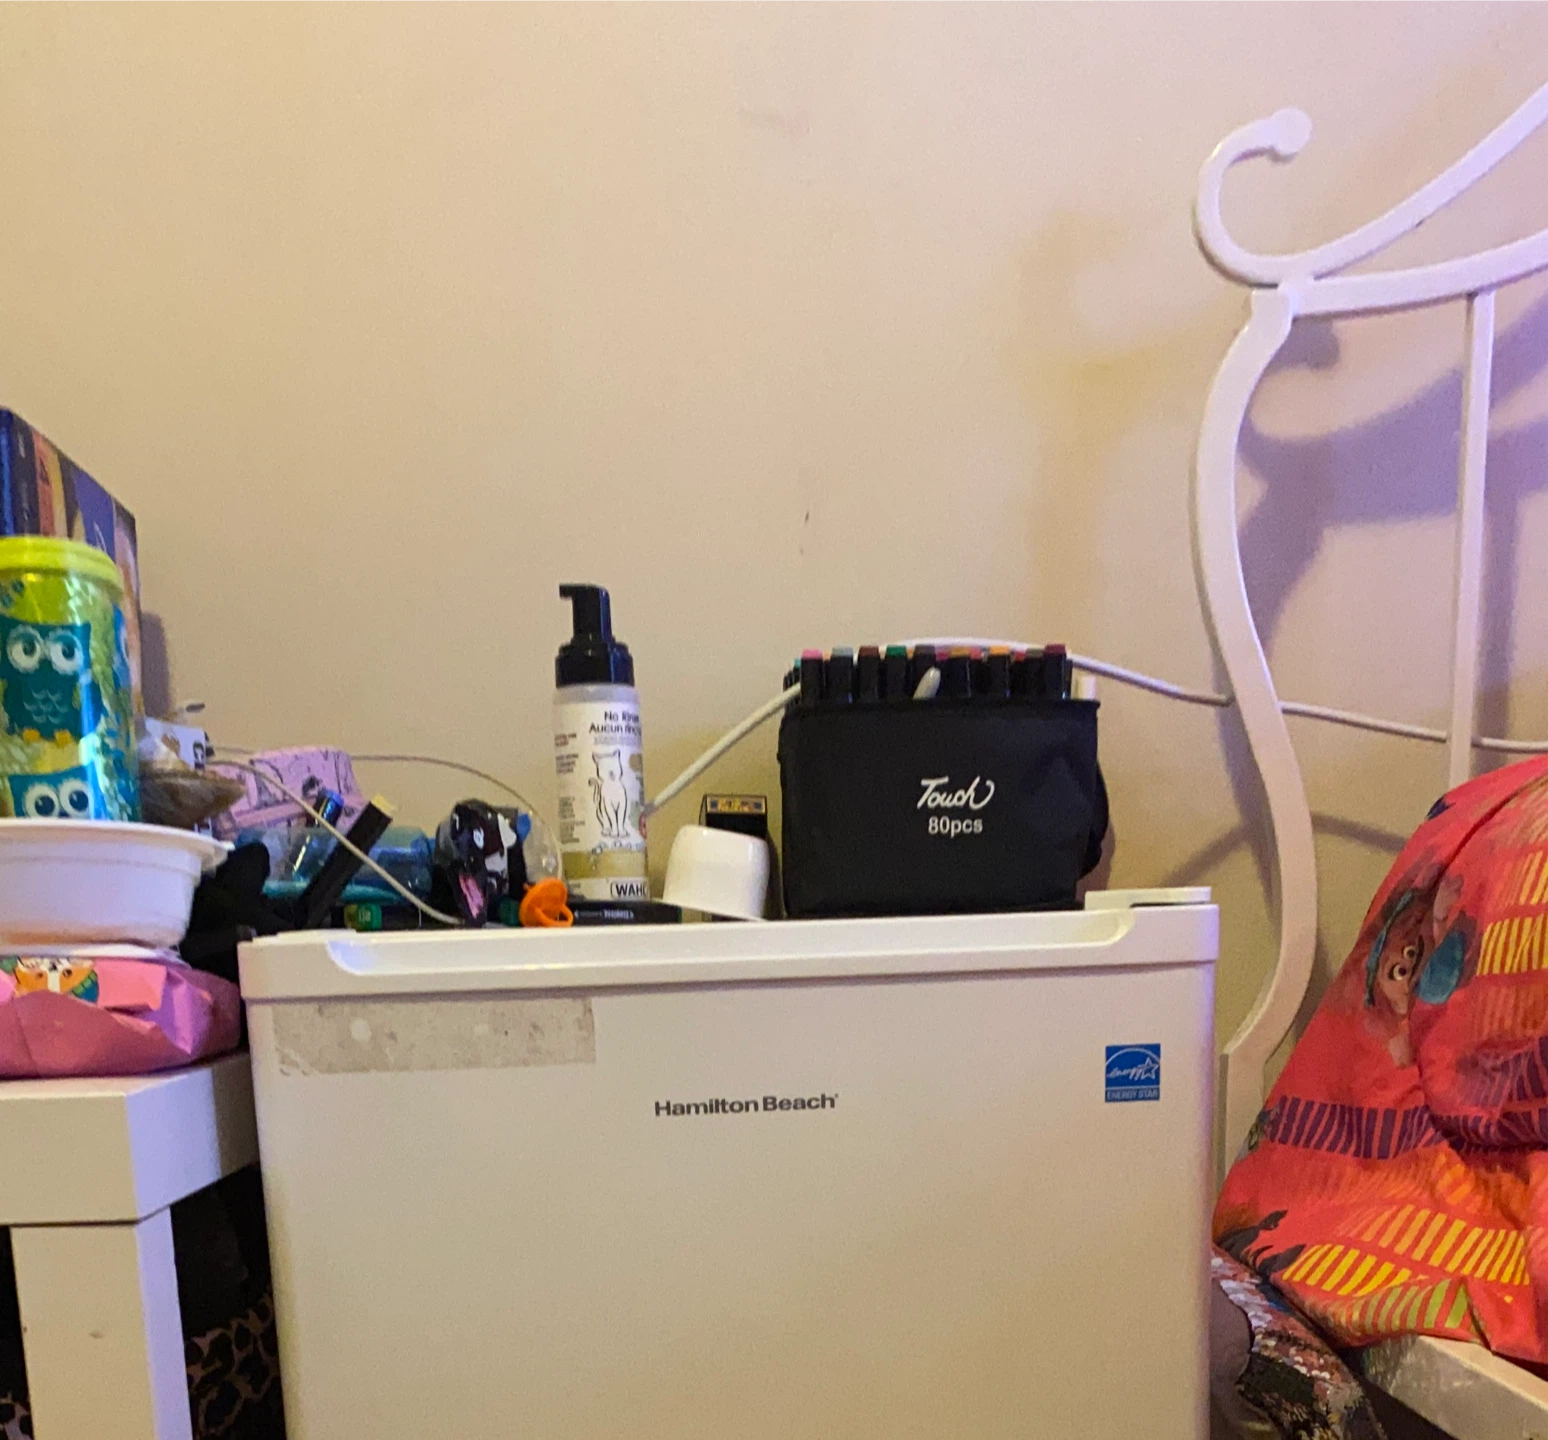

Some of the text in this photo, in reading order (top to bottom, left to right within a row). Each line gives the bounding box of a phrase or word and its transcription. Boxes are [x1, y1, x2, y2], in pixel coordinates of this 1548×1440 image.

[604, 710, 619, 721] No
[588, 722, 624, 734] Aucun
[917, 775, 996, 811] Touch
[928, 815, 984, 839] 80pcs
[654, 1093, 836, 1117] Hamilton Beach
